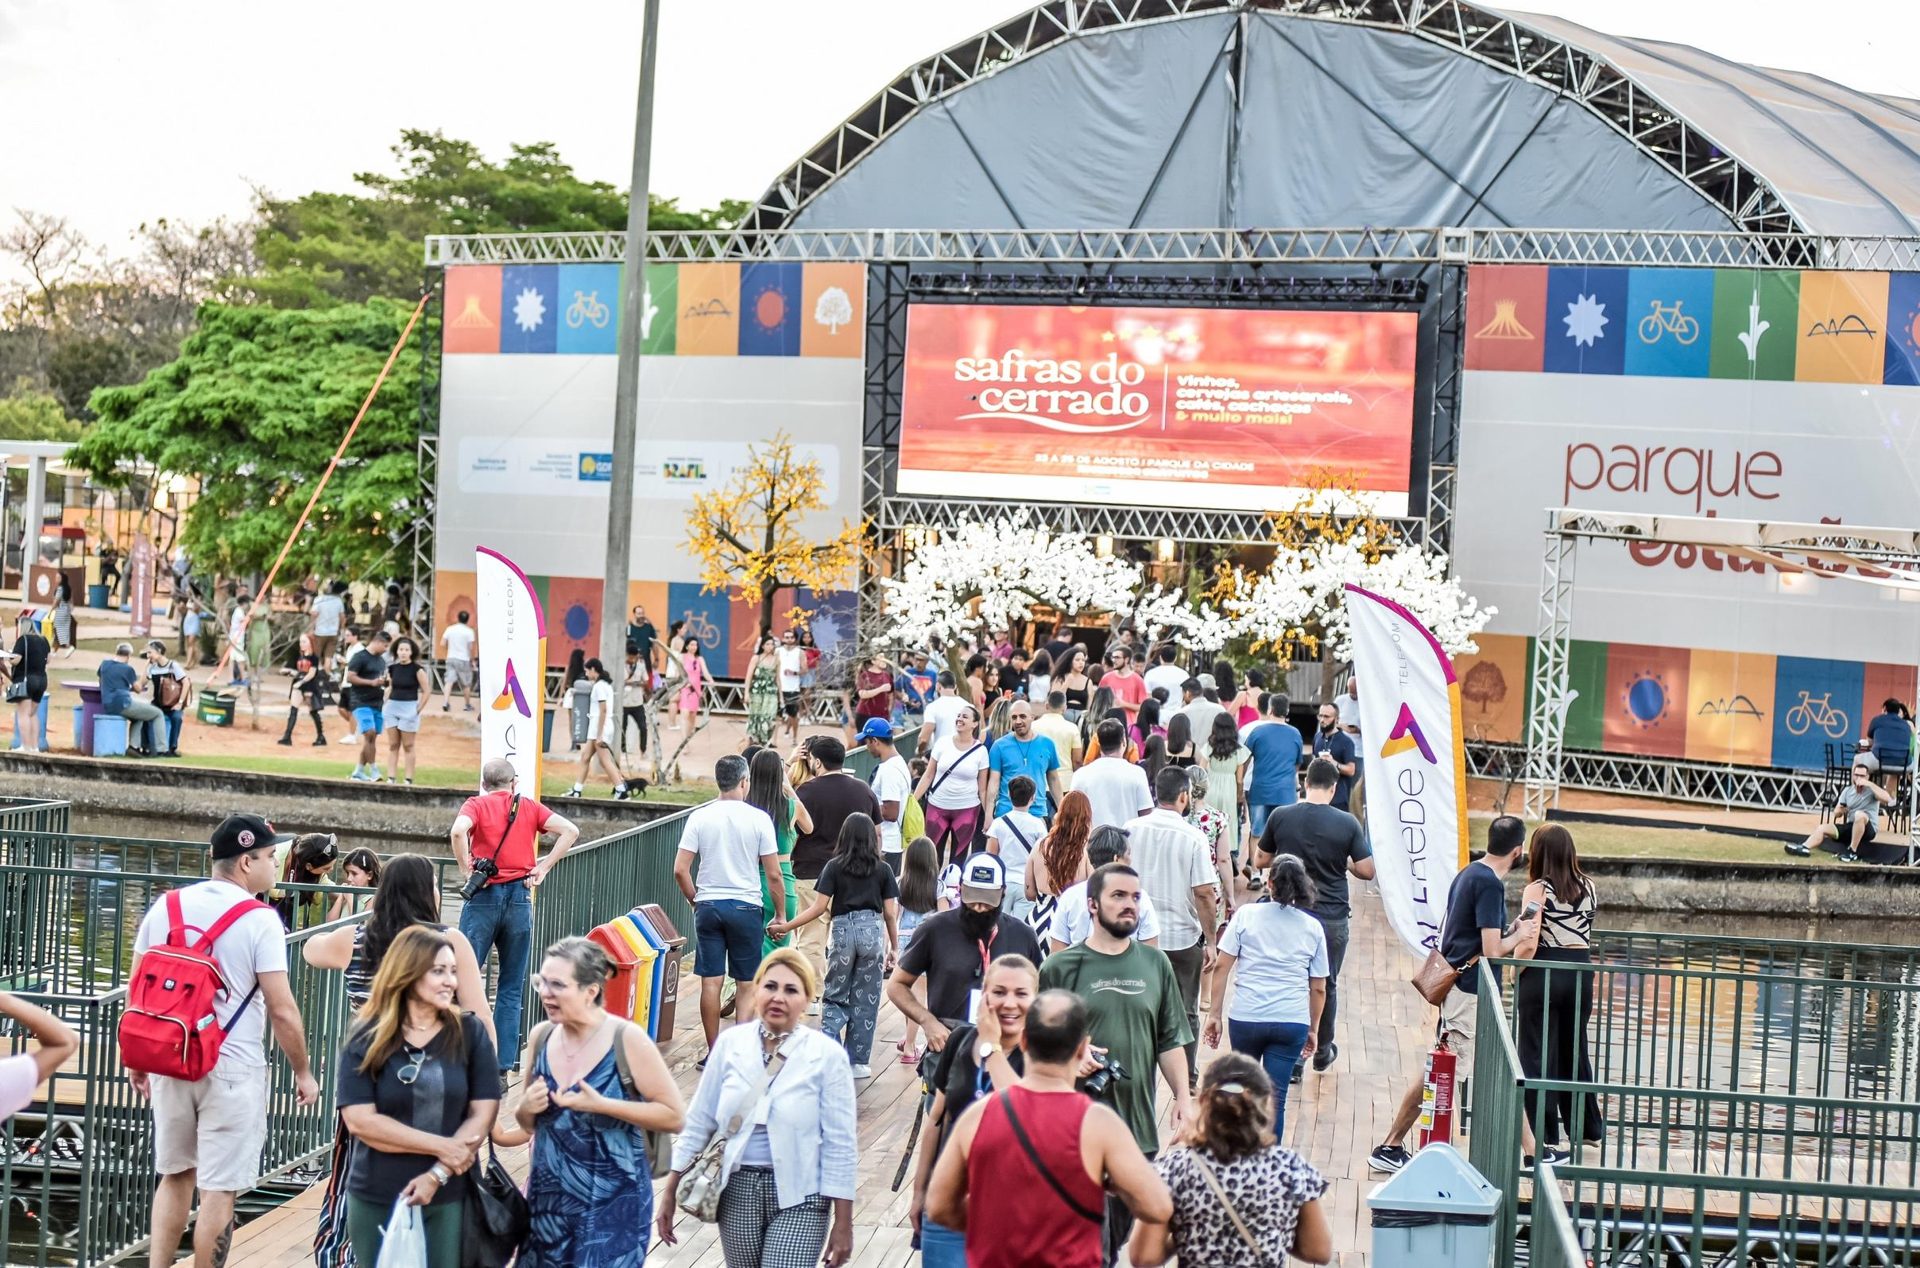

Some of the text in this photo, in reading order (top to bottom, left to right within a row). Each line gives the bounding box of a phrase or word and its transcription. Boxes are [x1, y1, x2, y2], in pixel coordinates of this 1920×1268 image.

[954, 350, 1145, 386] safras do
[978, 381, 1149, 416] cerrado
[1191, 411, 1242, 424] muito
[1563, 442, 1783, 513] parque
[506, 577, 514, 642] TELECOM
